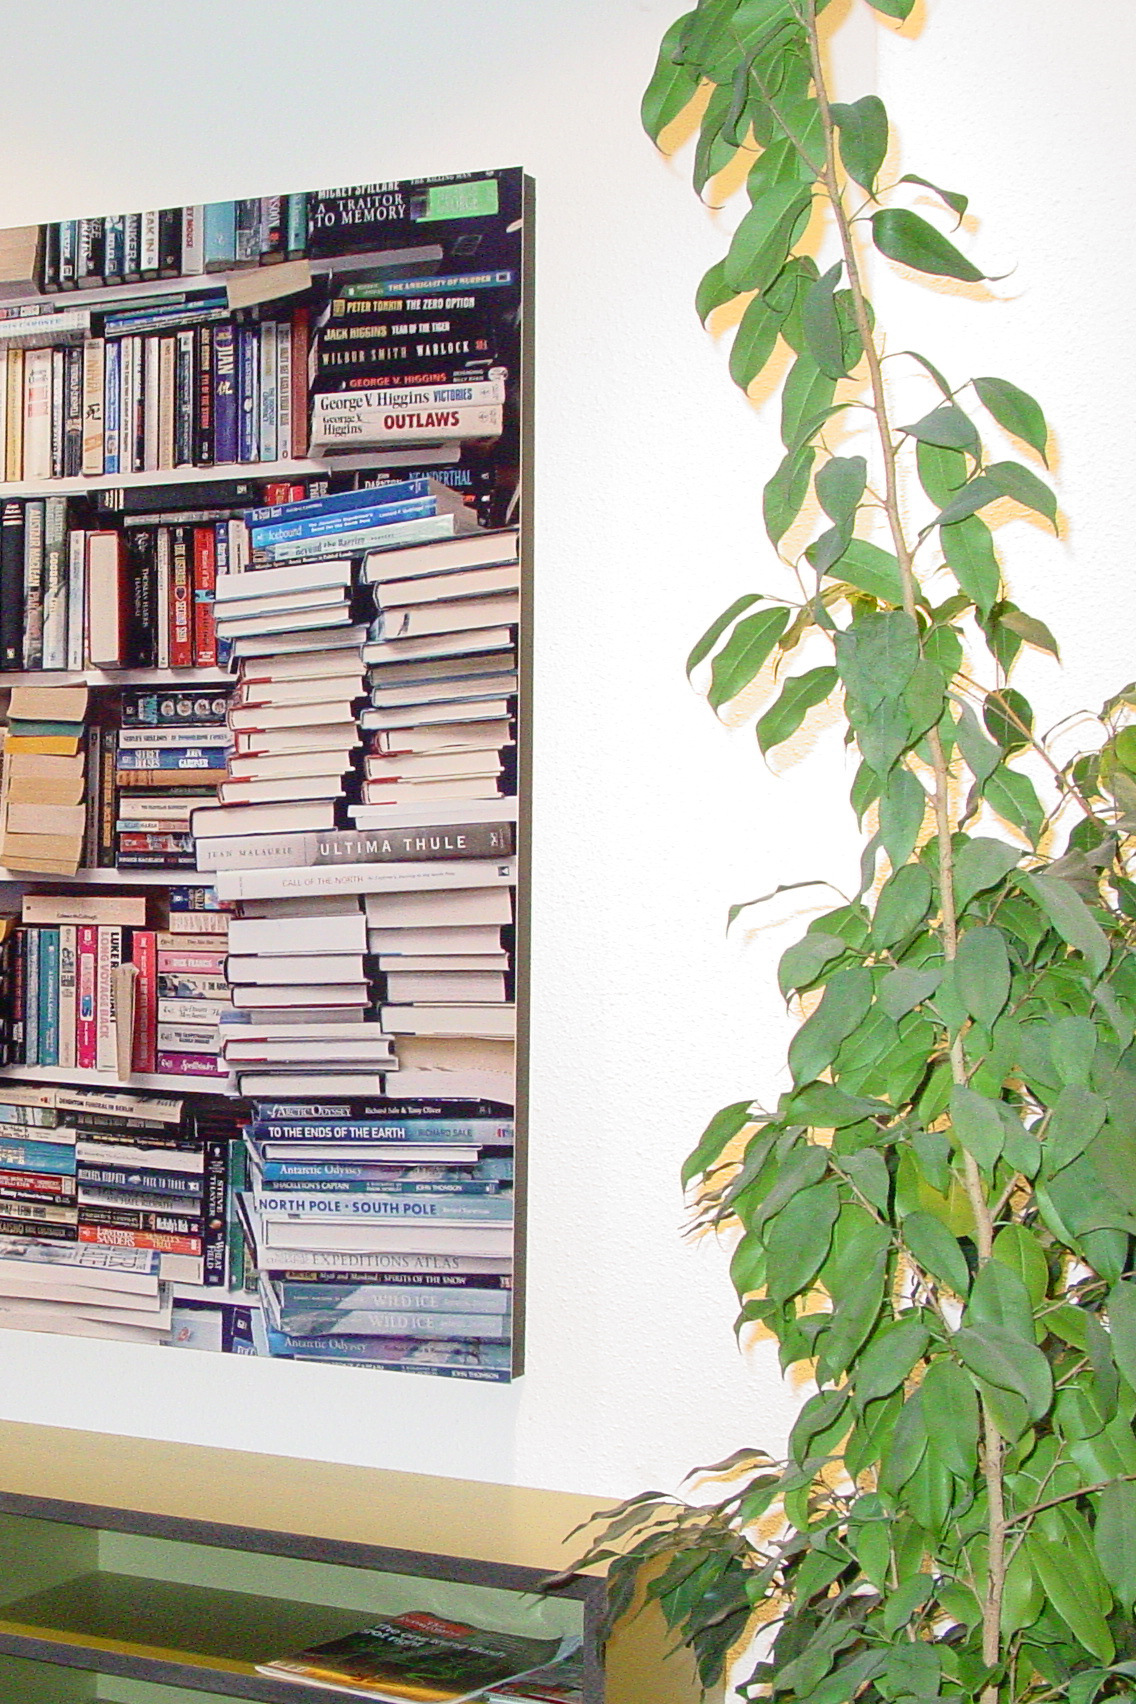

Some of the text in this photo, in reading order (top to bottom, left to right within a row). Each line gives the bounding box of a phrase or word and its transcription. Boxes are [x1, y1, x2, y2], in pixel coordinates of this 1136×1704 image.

[317, 202, 326, 214] A
[337, 193, 403, 212] TRAITOR
[314, 203, 406, 227] TO MEMORY
[128, 215, 137, 260] ANKER
[186, 218, 194, 249] MOUSE
[146, 238, 154, 253] IN
[346, 297, 475, 313] PETER THE ZERO OPTION
[324, 328, 347, 341] JACK
[349, 325, 387, 339] HIGGINS
[322, 340, 469, 365] WILBUR SMITH WARLOCK
[349, 376, 390, 388] GEORGE
[404, 372, 446, 384] HIGGINS
[320, 393, 363, 413] George
[376, 391, 430, 410] Higgins
[383, 411, 460, 430] OUTLAWS
[323, 423, 363, 437] Higgins
[28, 509, 41, 546] ALISTAIR
[320, 840, 392, 857] ULTIMA
[403, 835, 467, 851] THULE
[282, 878, 315, 888] CALL OF
[110, 931, 120, 962] LUKE
[100, 931, 109, 1038] LONG VOYAGE BACK
[85, 1101, 108, 1109] FUNERAL
[115, 1105, 134, 1113] BERLIN
[313, 1104, 351, 1118] ODYSSEY
[400, 1106, 407, 1114] &
[268, 1127, 472, 1139] TO THE ENDS OF THE EARTH RICHARD SALE
[279, 1165, 362, 1177] Antarctic Odyssey
[321, 1182, 350, 1190] CAPTAIN
[208, 1175, 216, 1217] THAYER
[216, 1179, 224, 1214] STEVE
[258, 1198, 436, 1215] NORTH POLE SOUTH POLE
[97, 1235, 136, 1247] SANDERS
[313, 1255, 460, 1269] EXPEDITIONS ATLAS
[412, 1275, 423, 1283] OF
[424, 1275, 440, 1284] THE
[371, 1296, 438, 1308] WILD ICE
[367, 1316, 434, 1328] WILD ICE
[284, 1337, 366, 1352] Antarctic Odyssey
